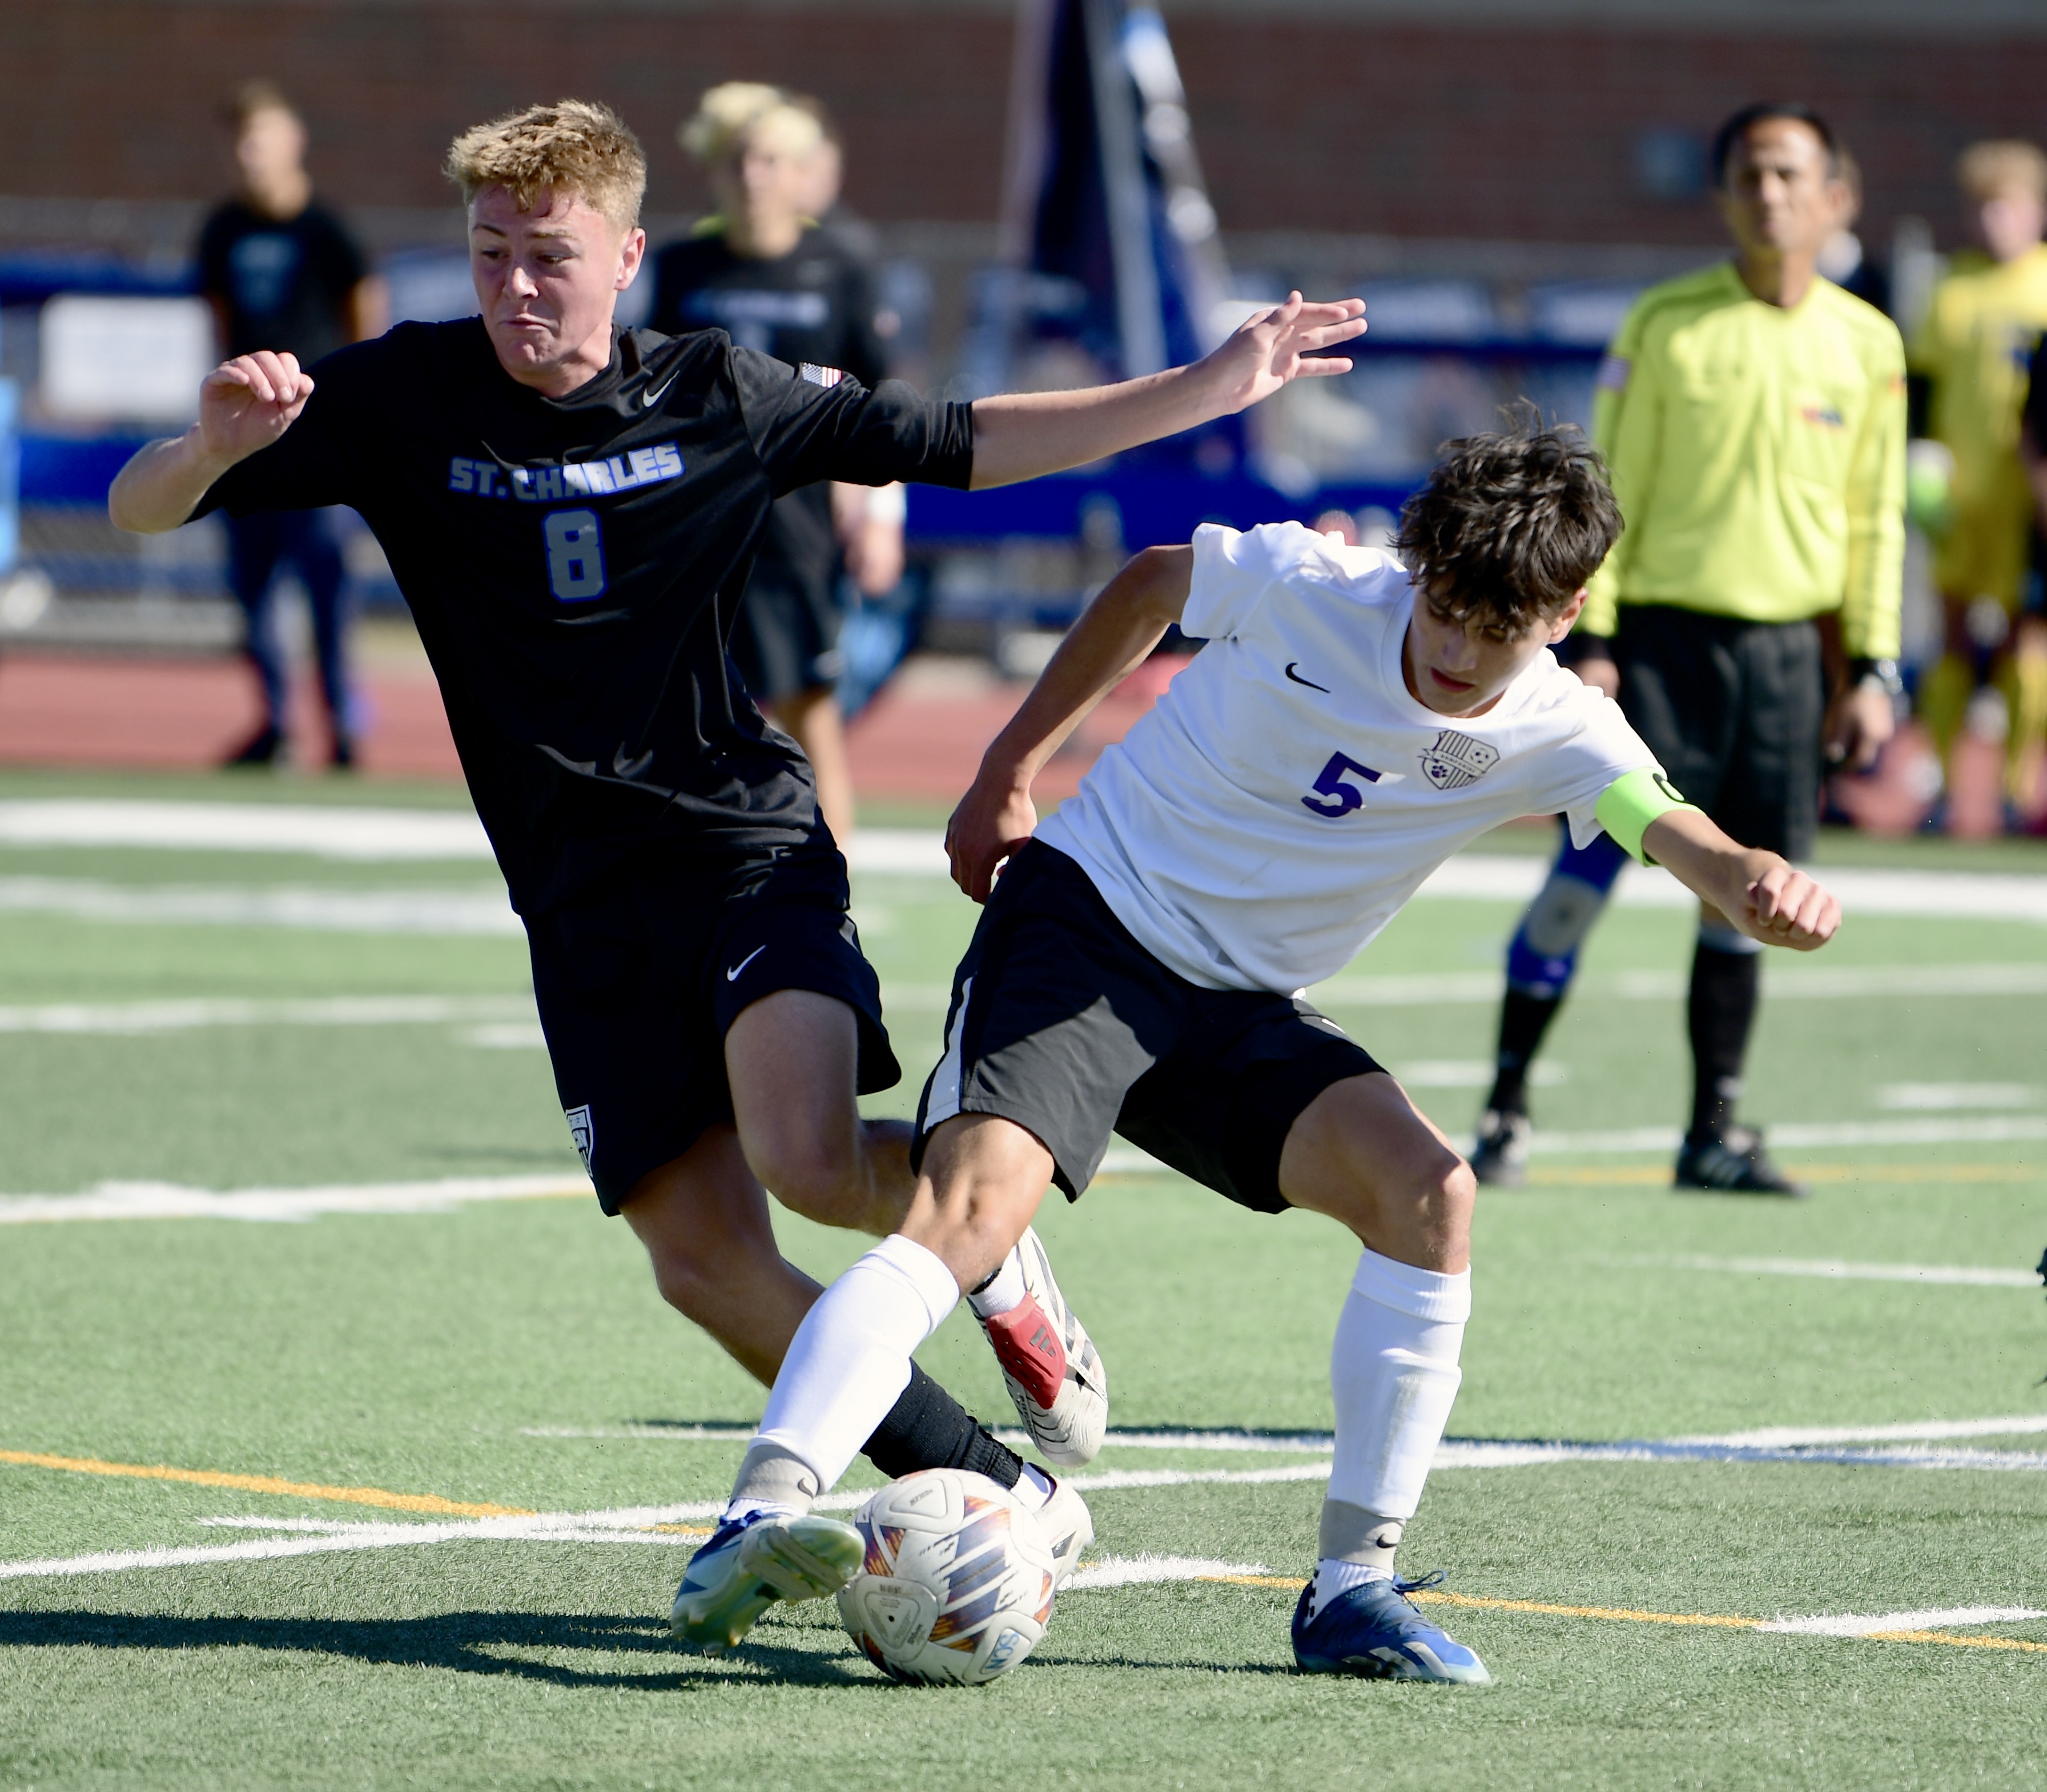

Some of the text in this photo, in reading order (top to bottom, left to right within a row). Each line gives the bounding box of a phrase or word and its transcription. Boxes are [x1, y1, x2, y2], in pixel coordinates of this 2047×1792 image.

[449, 440, 685, 502] ST. CHARLES
[541, 506, 608, 603] 8
[1301, 751, 1382, 818] 5
